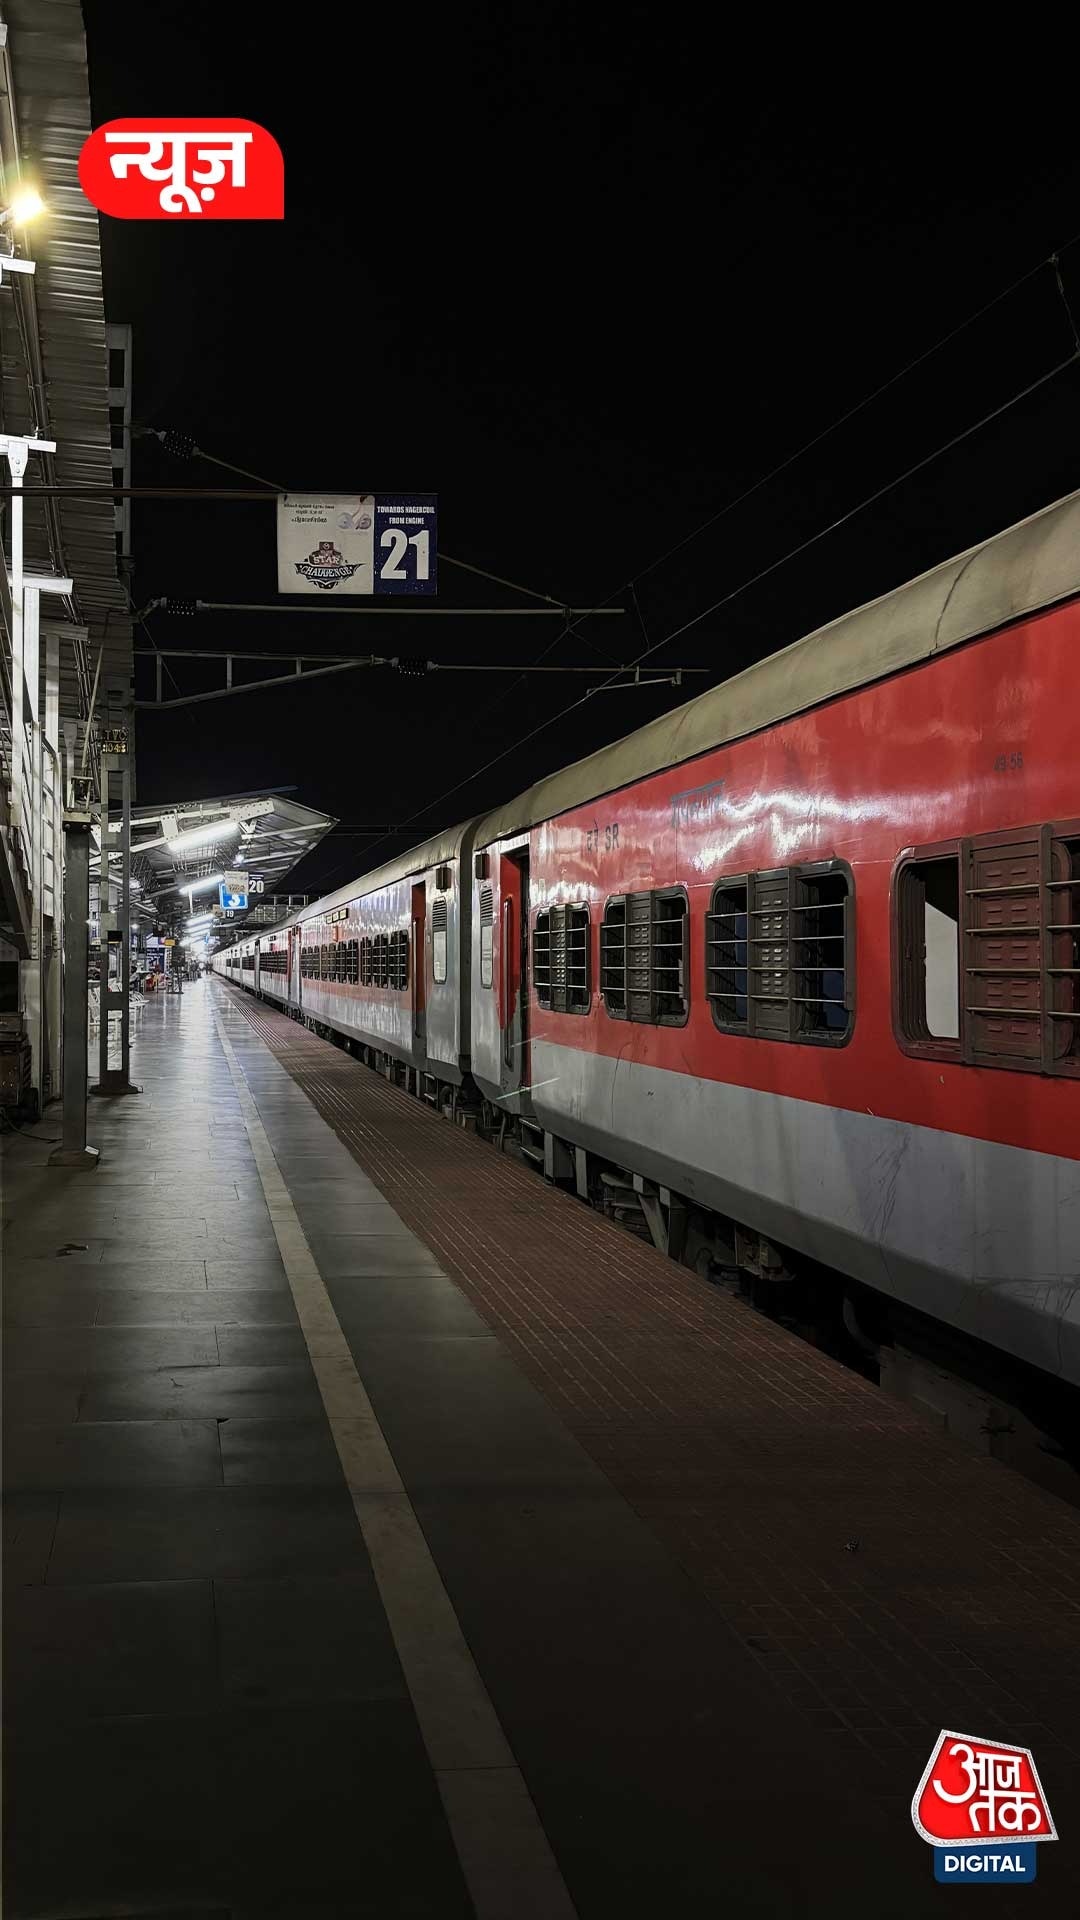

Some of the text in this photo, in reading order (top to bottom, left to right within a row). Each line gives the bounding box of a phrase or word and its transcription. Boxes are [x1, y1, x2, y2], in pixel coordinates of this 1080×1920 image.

[377, 506, 404, 514] TOWARDS
[313, 555, 340, 565] STAR
[380, 528, 430, 580] 21
[605, 823, 619, 851] SR
[249, 880, 264, 893] 20
